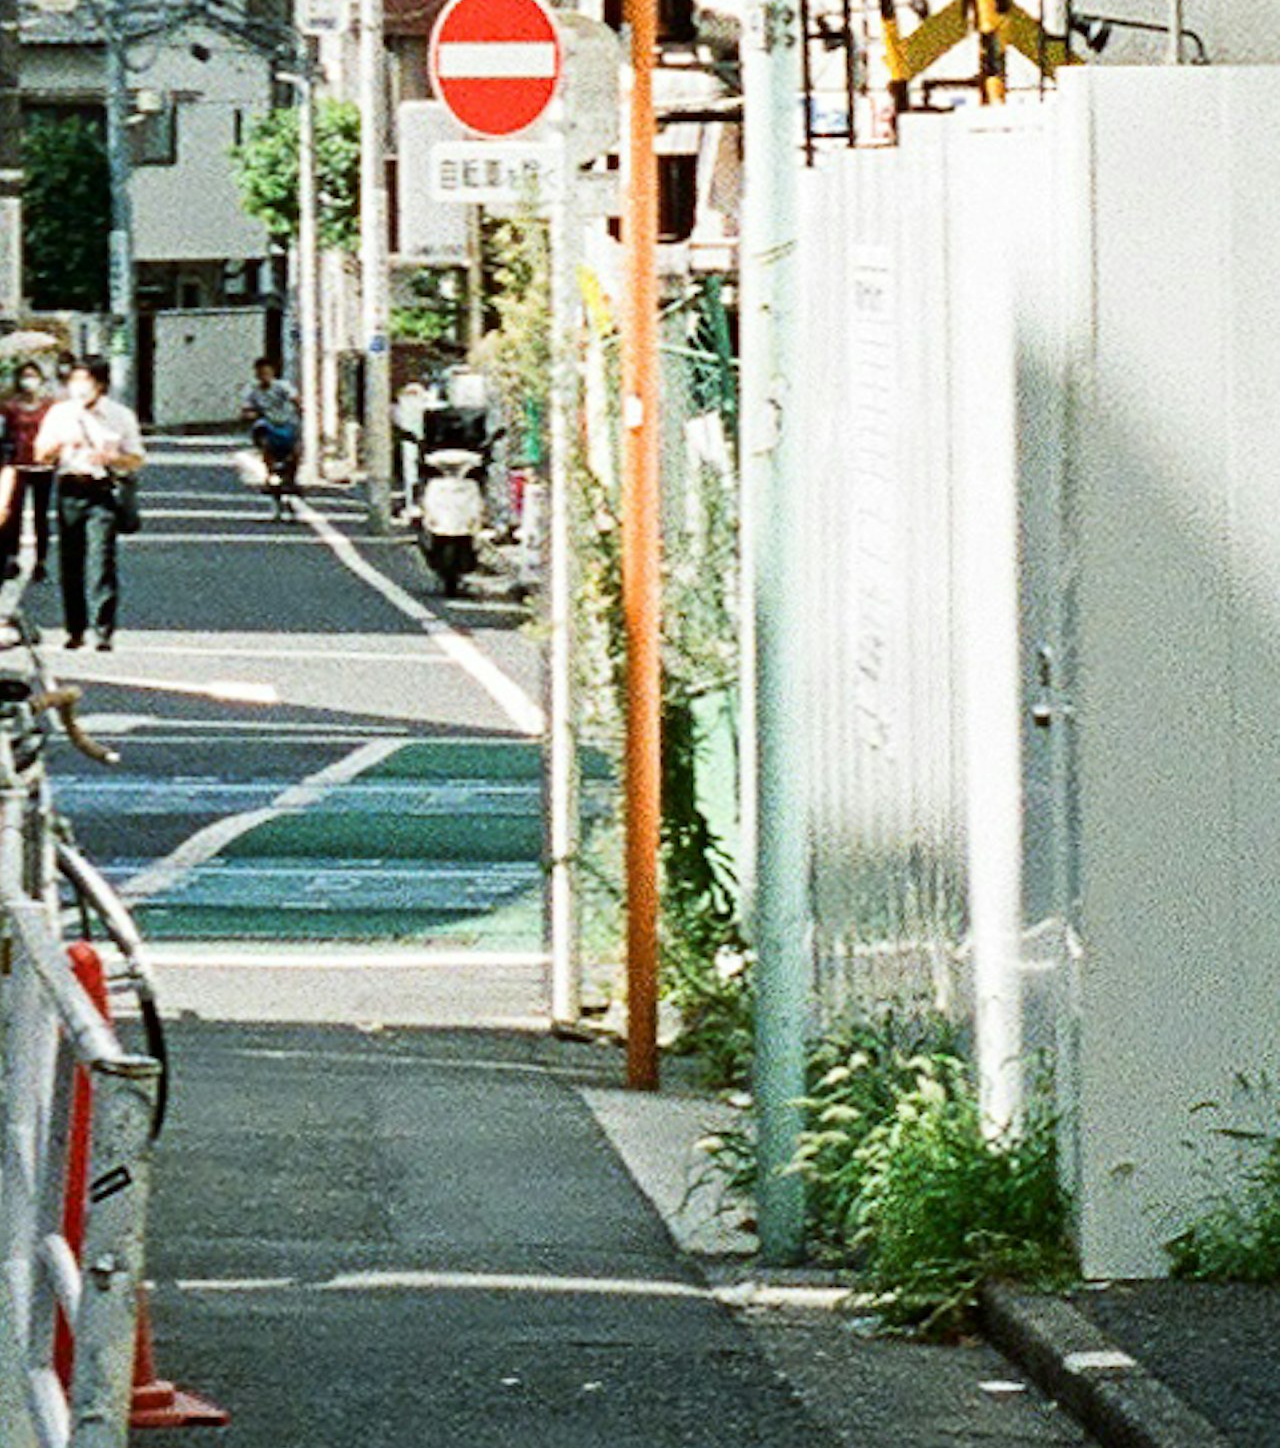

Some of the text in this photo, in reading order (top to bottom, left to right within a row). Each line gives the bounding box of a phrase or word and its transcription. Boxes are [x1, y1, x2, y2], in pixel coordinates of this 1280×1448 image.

[440, 158, 557, 192] 自転車を除く
